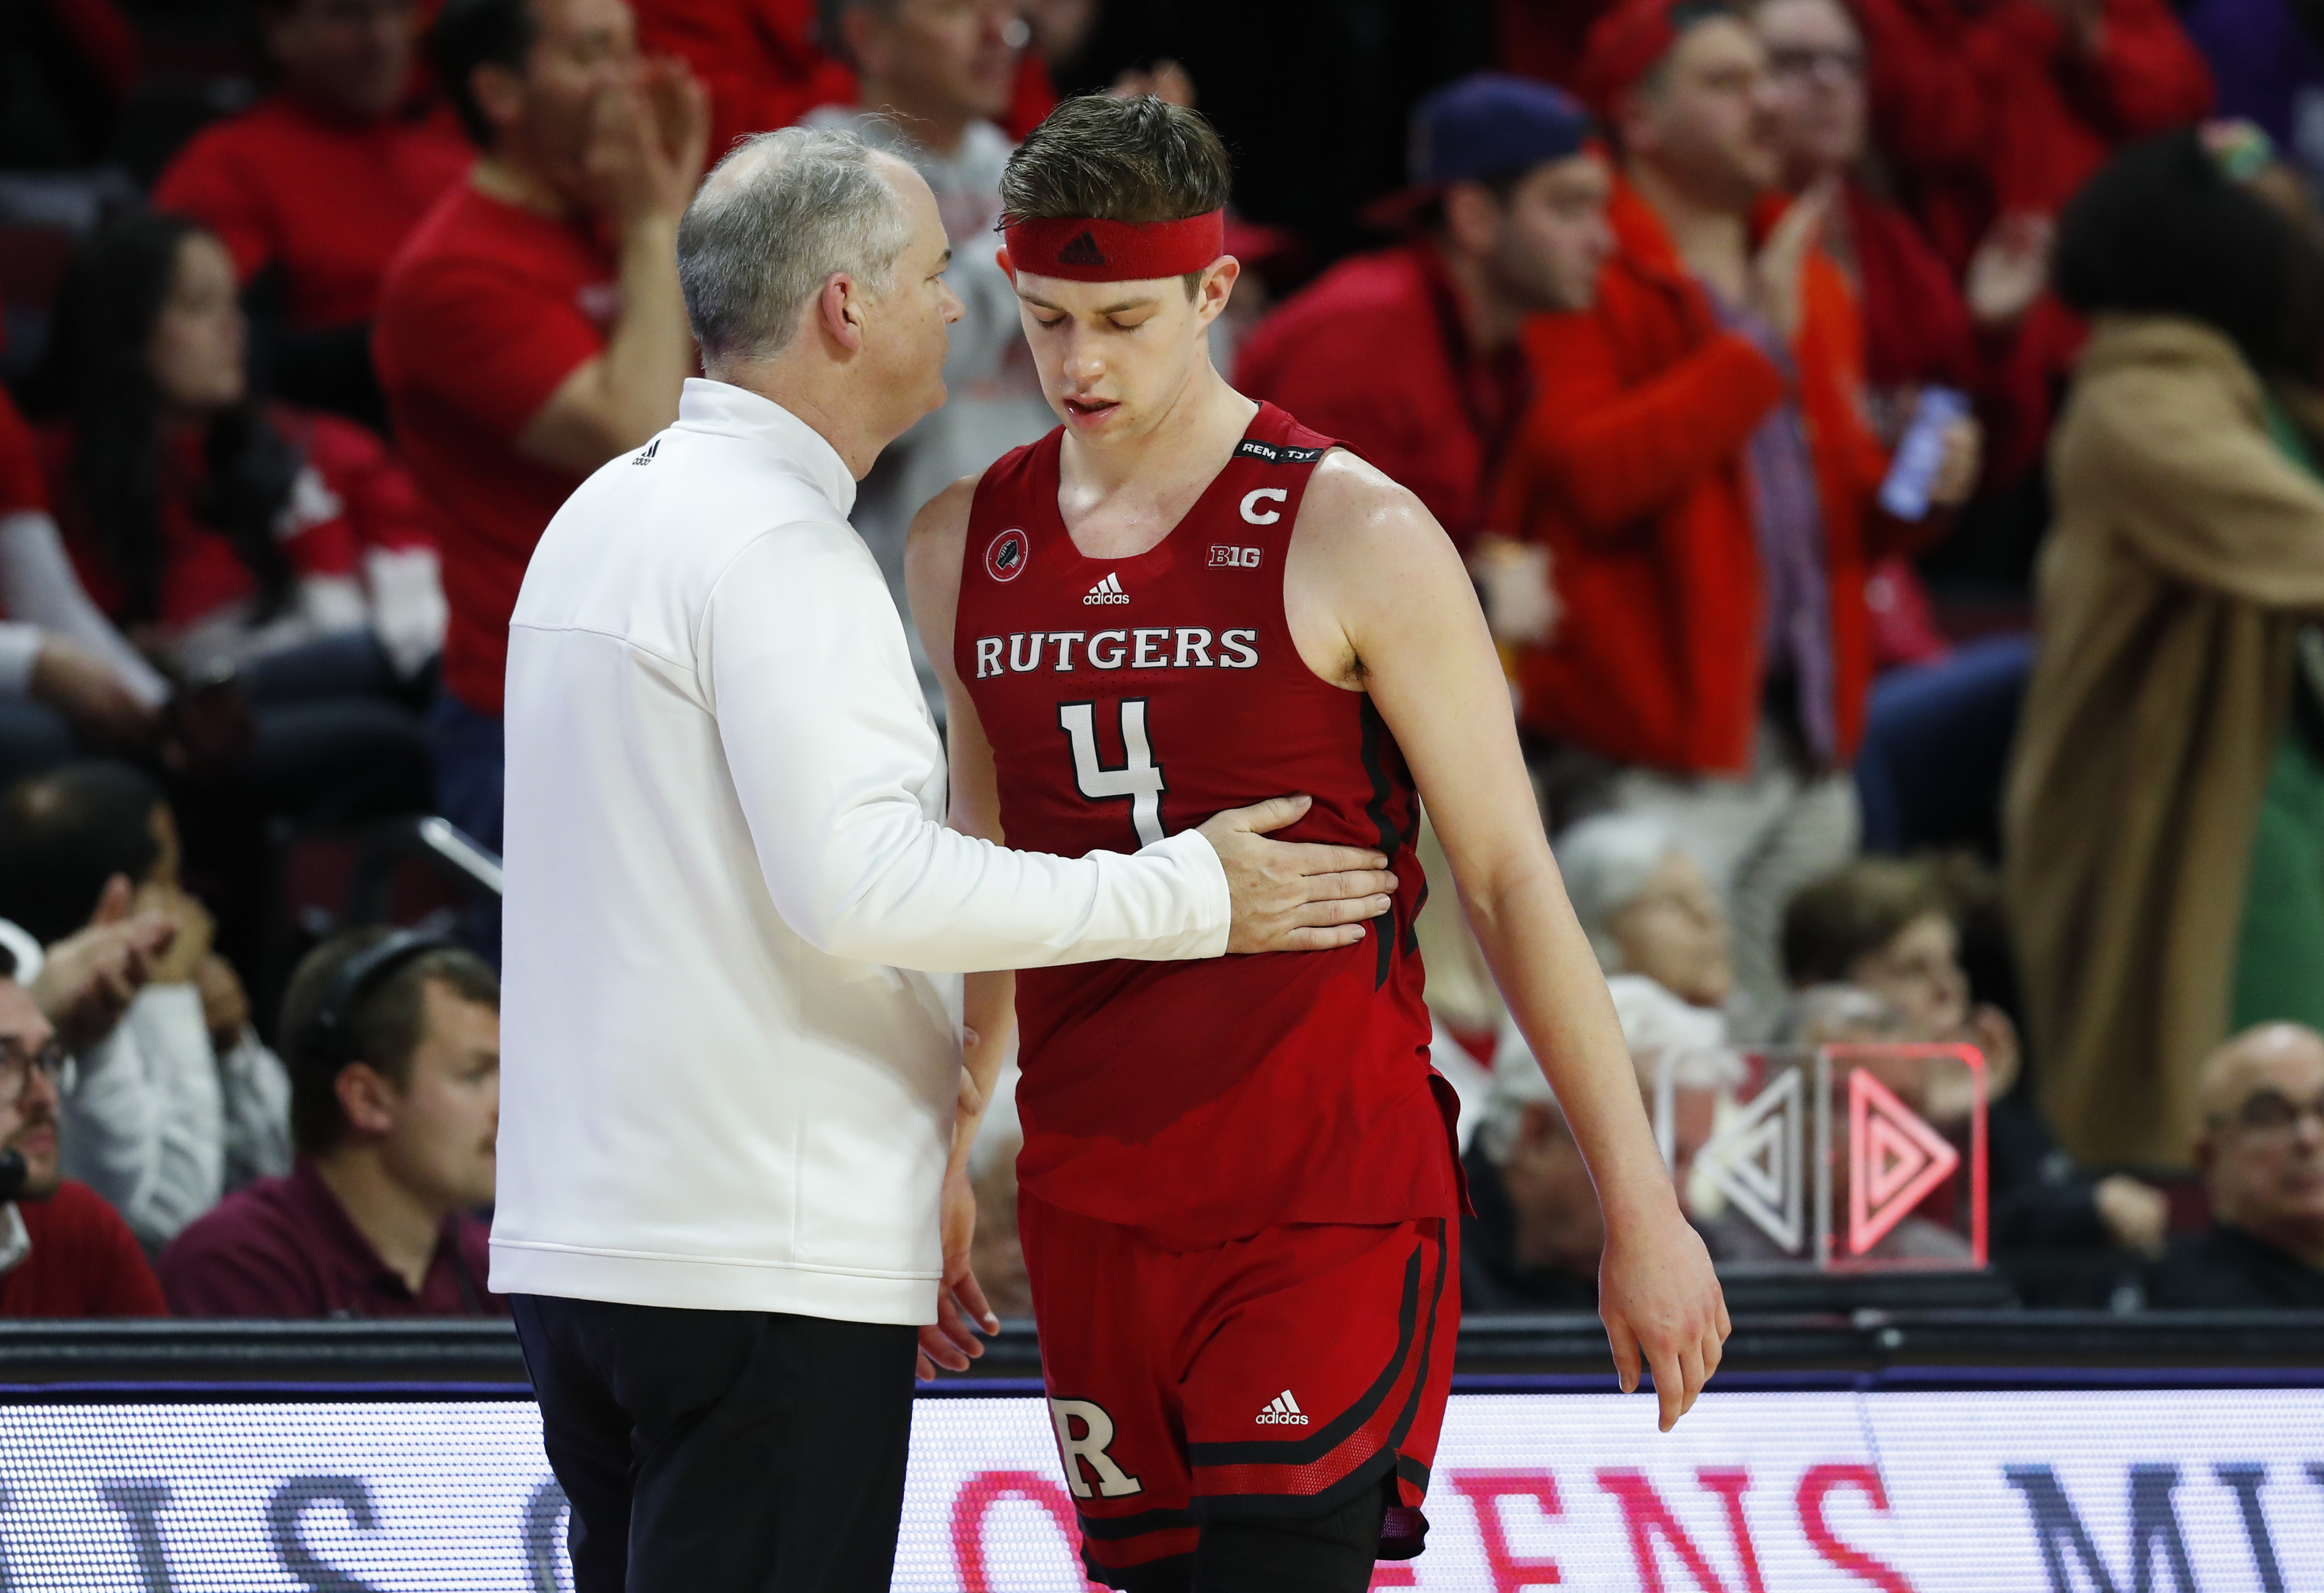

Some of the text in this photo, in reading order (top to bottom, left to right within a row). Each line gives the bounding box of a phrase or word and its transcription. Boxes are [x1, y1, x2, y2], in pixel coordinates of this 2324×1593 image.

[1242, 443, 1315, 460] REM TJY
[1240, 488, 1288, 525] C
[1083, 592, 1130, 606] adidas
[975, 626, 1259, 680] RUTGERS
[1056, 696, 1170, 850] 4
[1255, 1411, 1309, 1425] adidas
[1050, 1394, 1146, 1501] R
